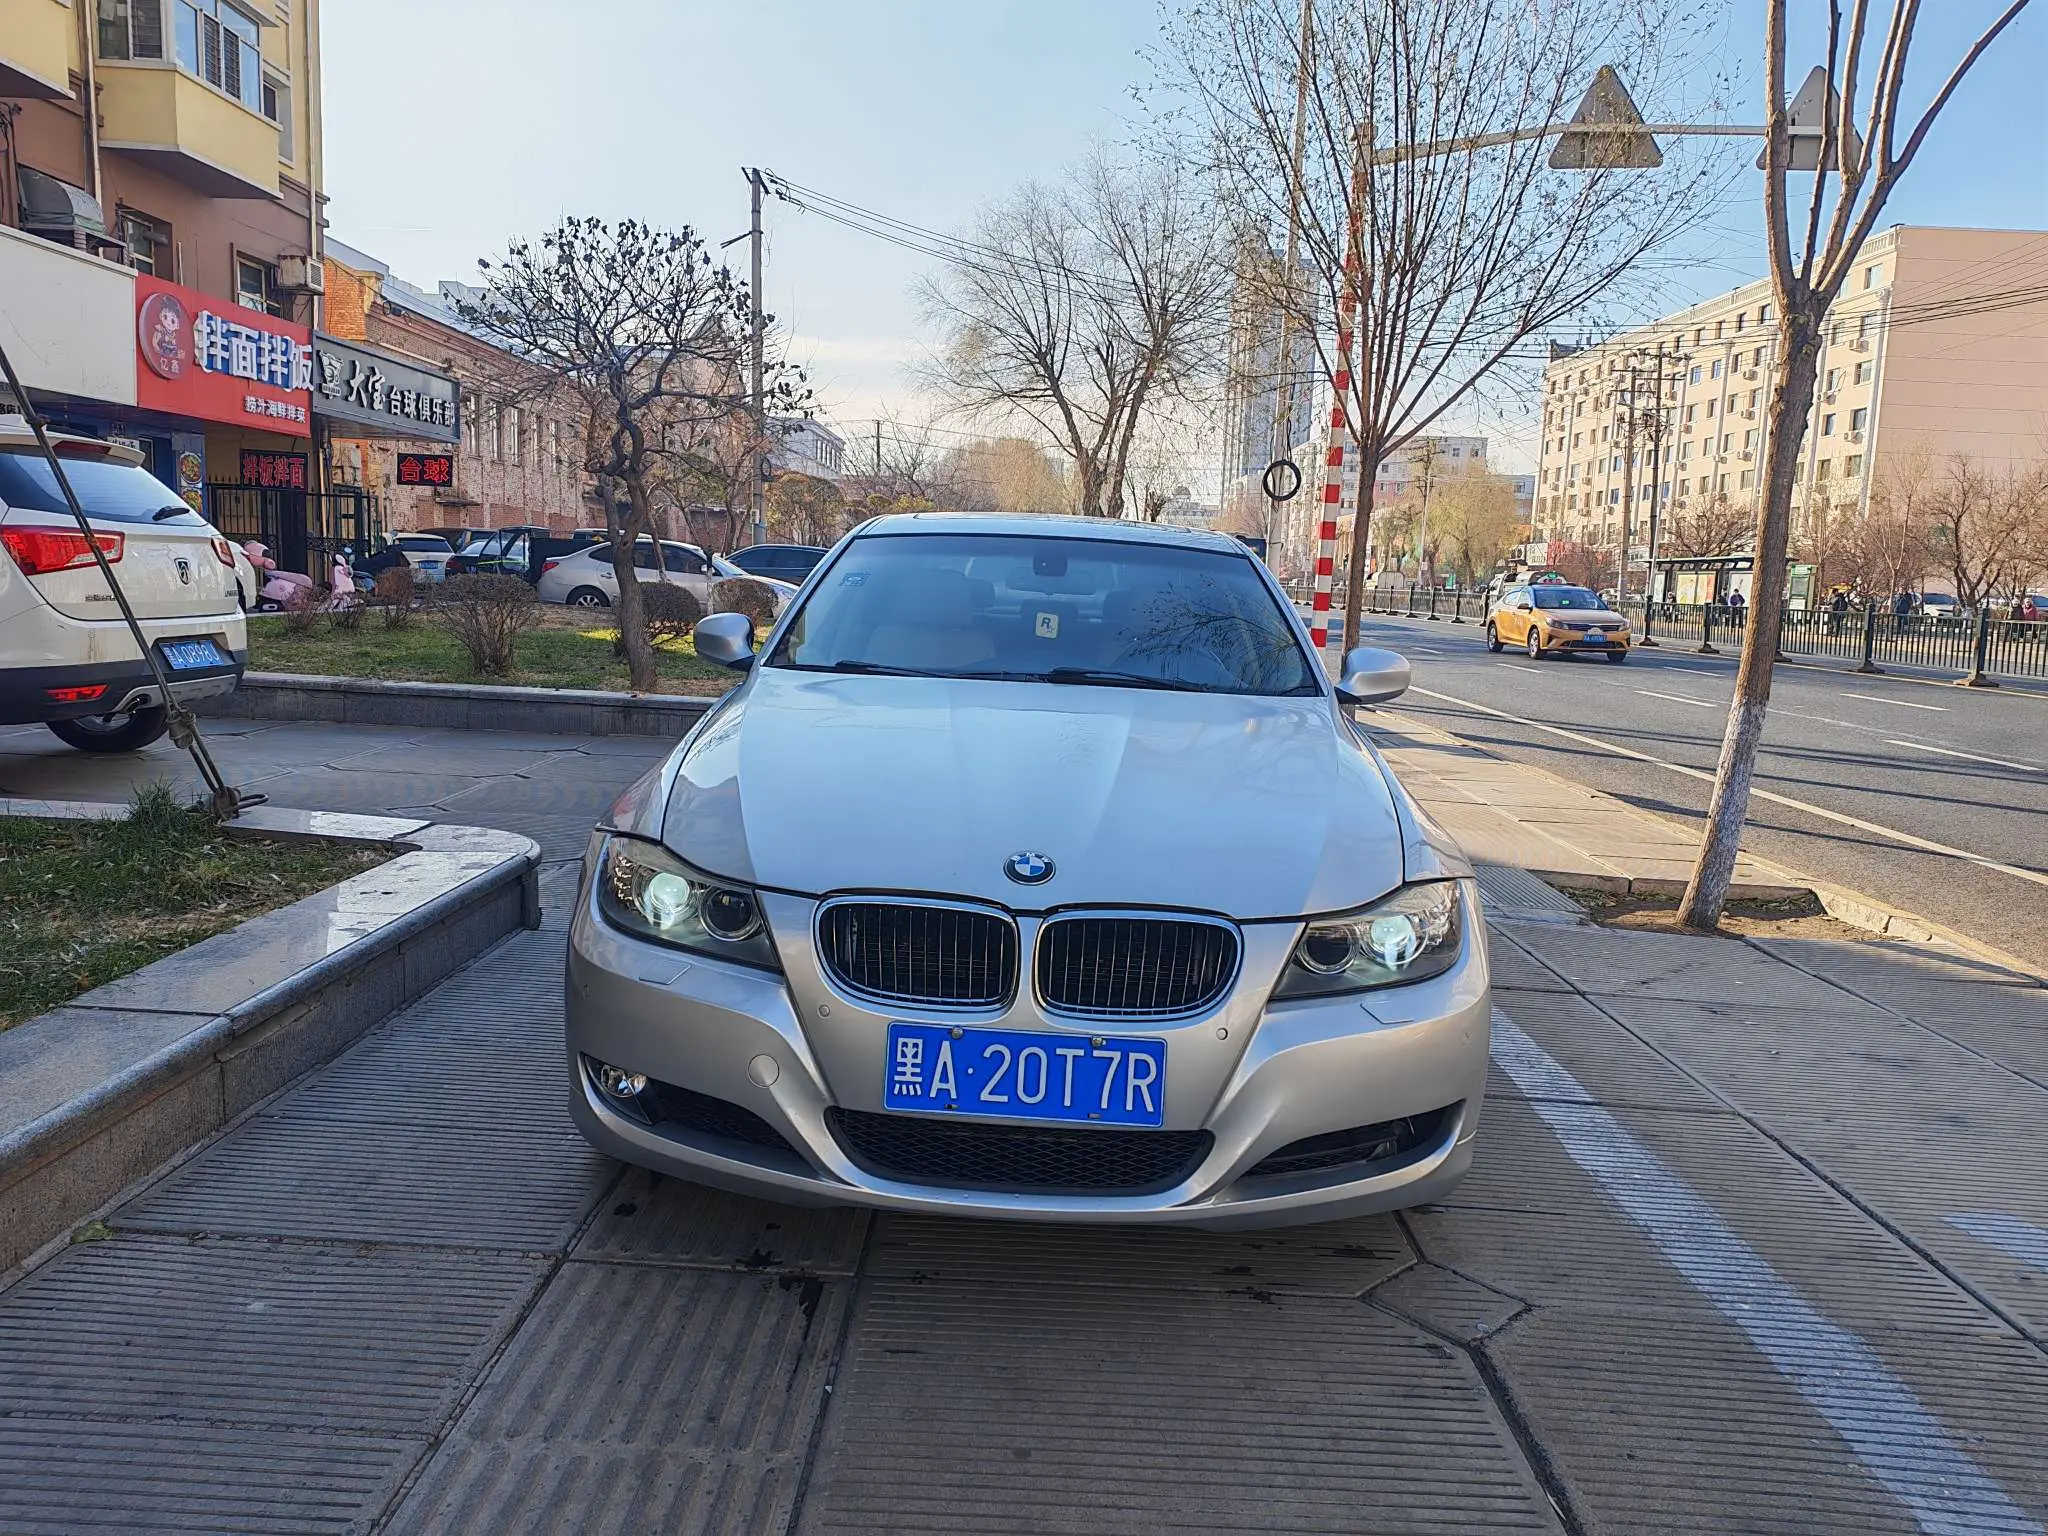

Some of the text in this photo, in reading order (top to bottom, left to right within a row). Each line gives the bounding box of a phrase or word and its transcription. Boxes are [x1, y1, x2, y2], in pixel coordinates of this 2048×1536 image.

[194, 310, 314, 391] 拌面拌饭
[243, 454, 305, 488] 拌饭拌面
[400, 456, 450, 483] 台球
